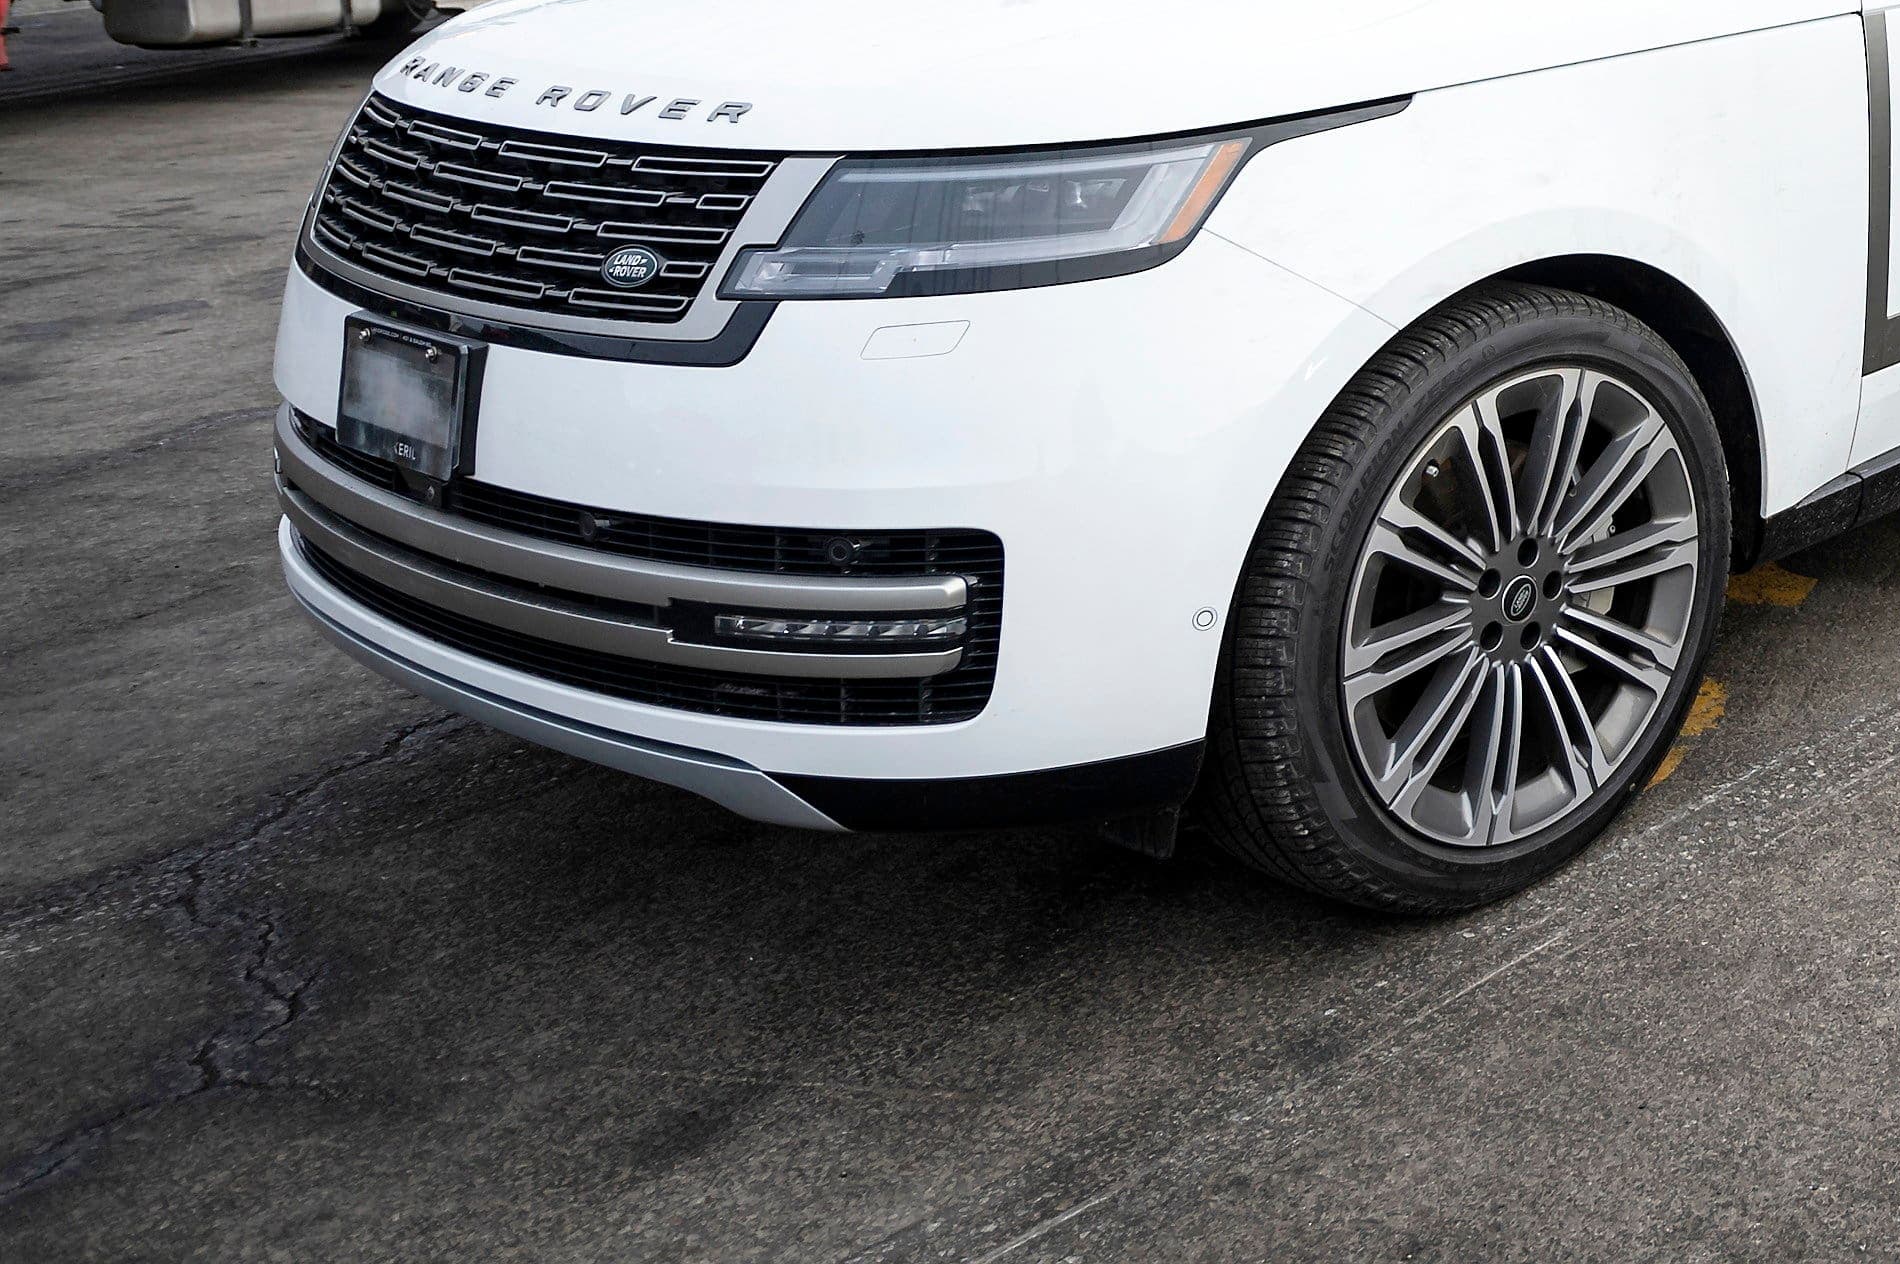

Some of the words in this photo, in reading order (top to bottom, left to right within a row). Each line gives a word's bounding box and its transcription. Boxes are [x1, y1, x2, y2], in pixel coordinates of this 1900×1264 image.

[400, 55, 518, 98] RANGE
[536, 85, 753, 124] ROVER
[613, 254, 642, 266] LAND
[613, 265, 647, 278] ROVER
